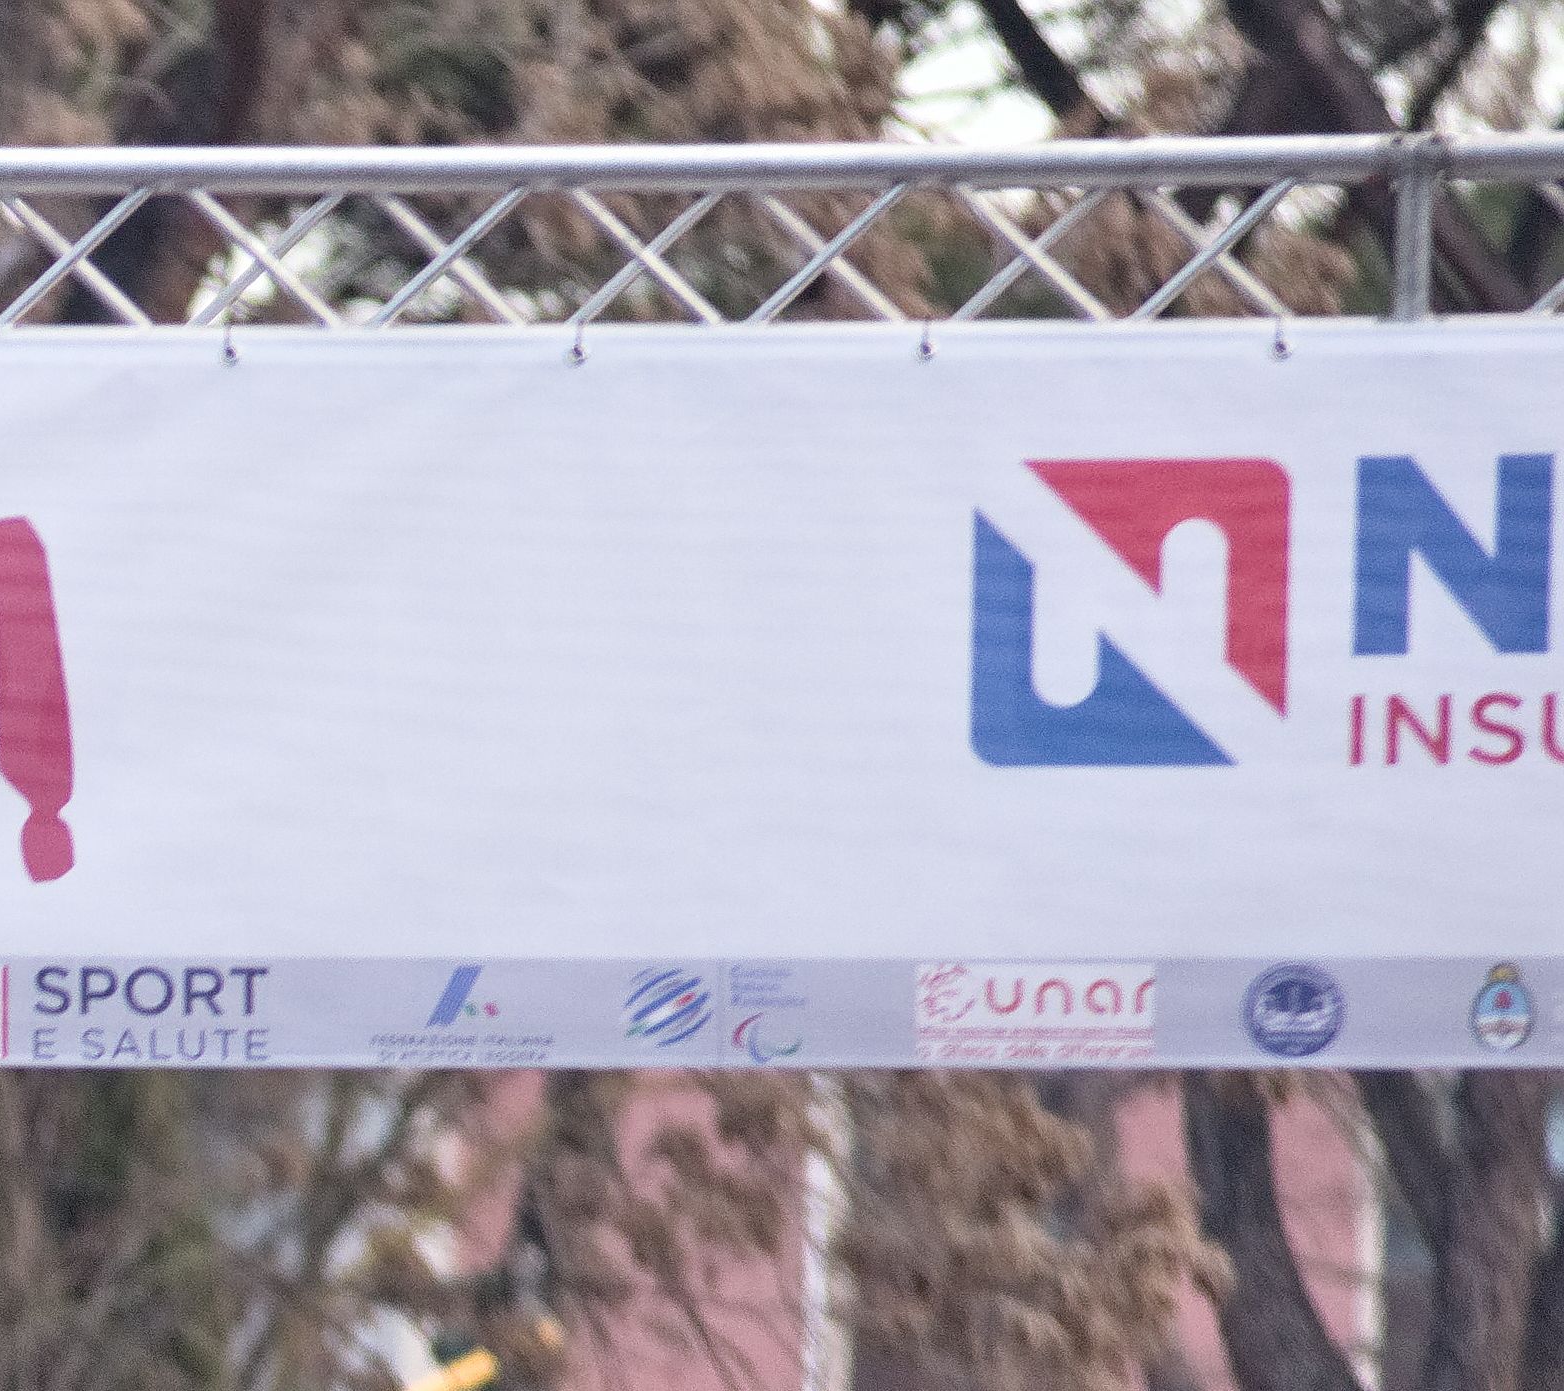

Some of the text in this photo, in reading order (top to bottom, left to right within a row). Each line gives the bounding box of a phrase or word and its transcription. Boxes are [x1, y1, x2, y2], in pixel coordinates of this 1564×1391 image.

[33, 965, 270, 1017] SPORT
[985, 977, 1157, 1016] unar
[32, 1027, 271, 1061] E SALUTE
